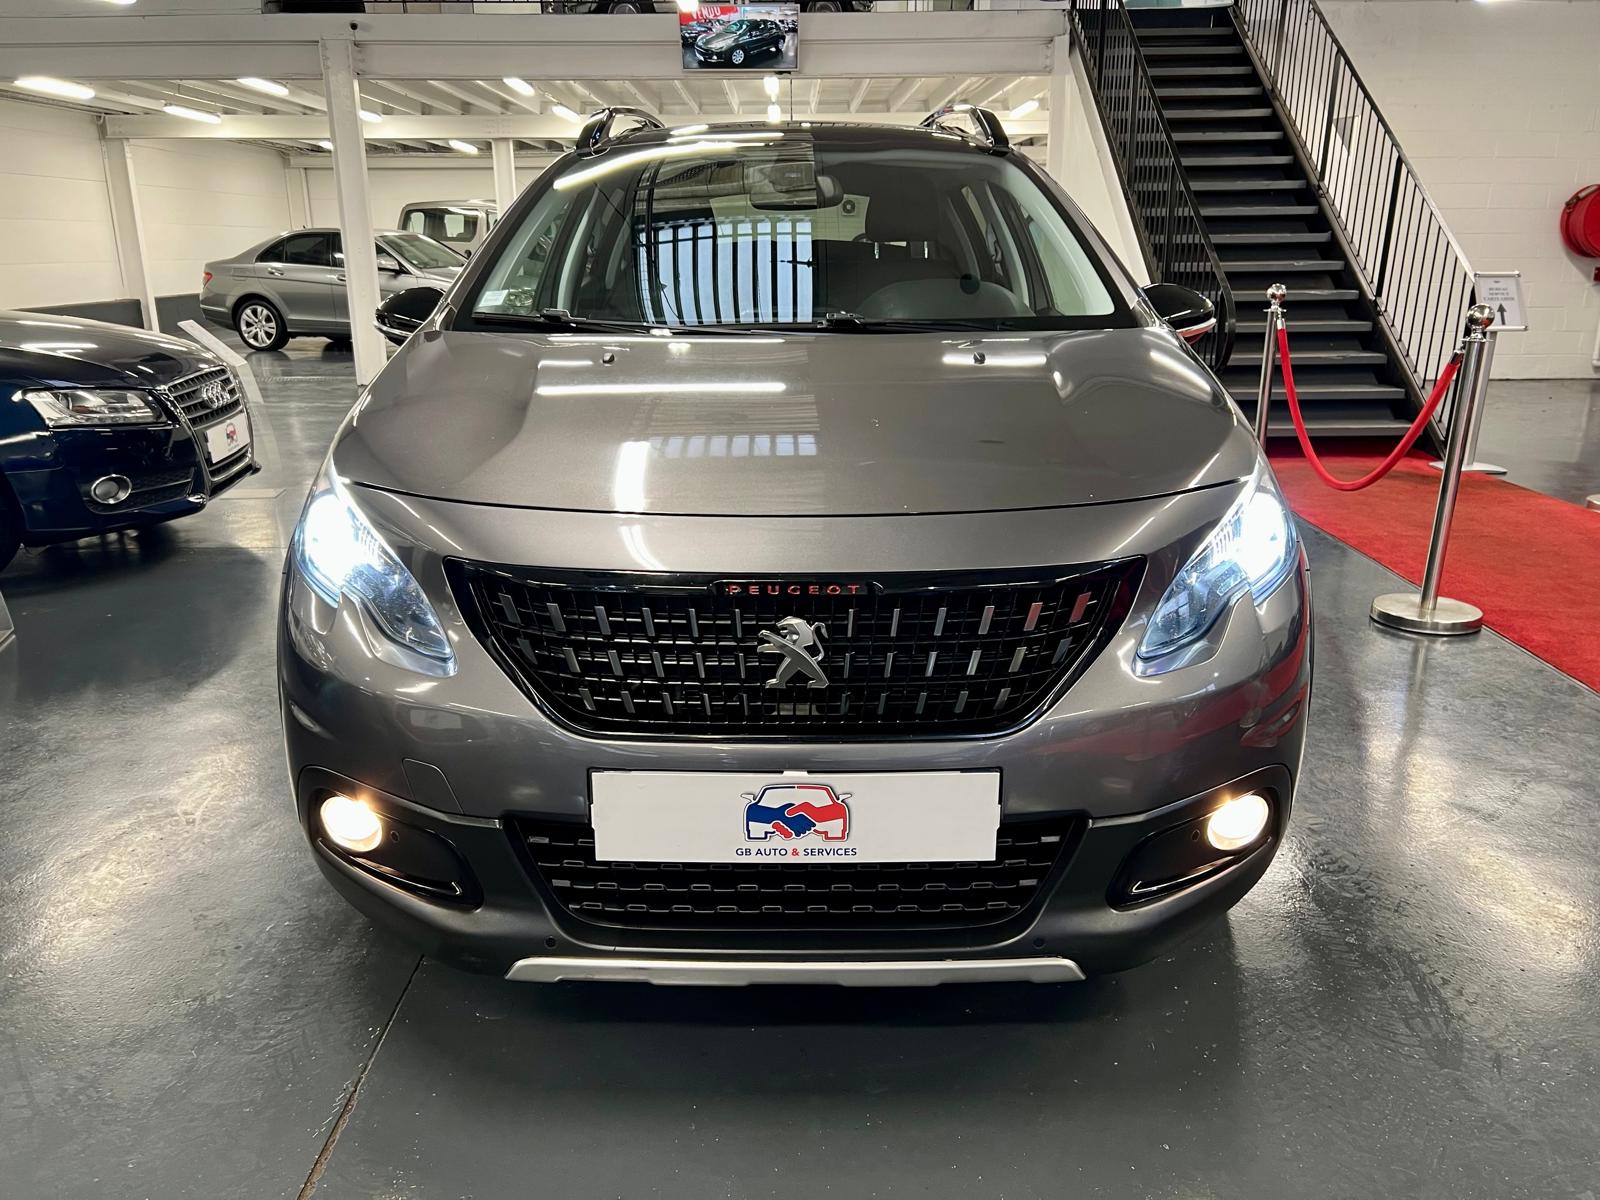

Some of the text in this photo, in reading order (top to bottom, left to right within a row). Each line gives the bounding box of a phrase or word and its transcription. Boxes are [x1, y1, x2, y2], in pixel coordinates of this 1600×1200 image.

[727, 585, 860, 595] PEUGEOT
[735, 848, 857, 856] GB AUTO & SERVICES
